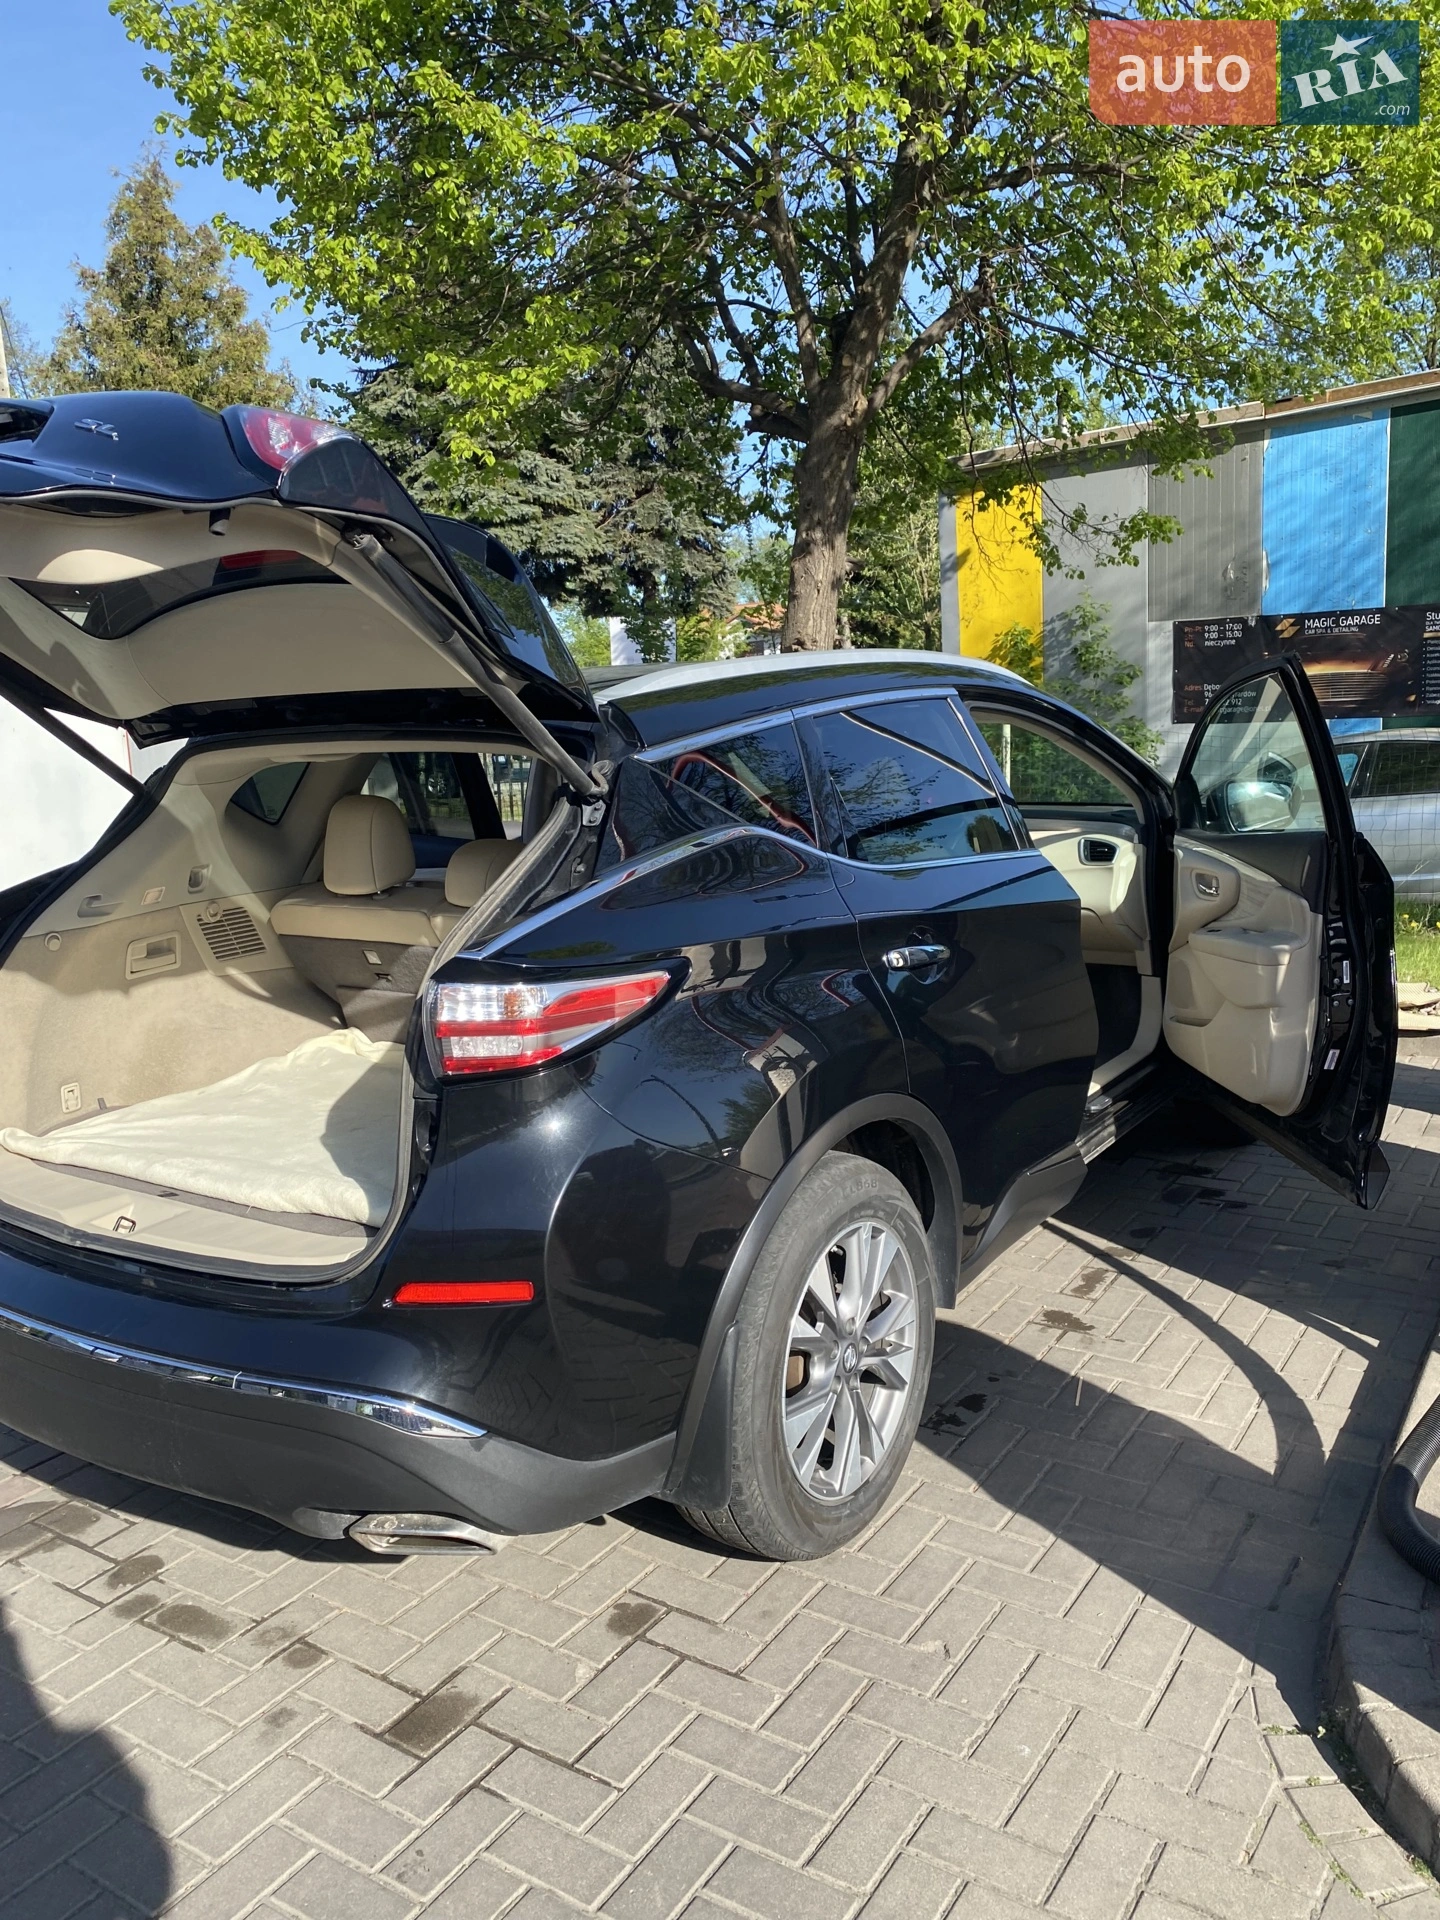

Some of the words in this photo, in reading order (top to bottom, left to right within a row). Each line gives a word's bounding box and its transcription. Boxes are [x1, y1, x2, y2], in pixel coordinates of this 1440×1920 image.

[74, 418, 119, 441] SL
[1226, 623, 1242, 631] 17:00
[1304, 616, 1337, 629] MAGIC
[1339, 614, 1381, 627] GARAGE
[1204, 639, 1236, 647] nieczynne
